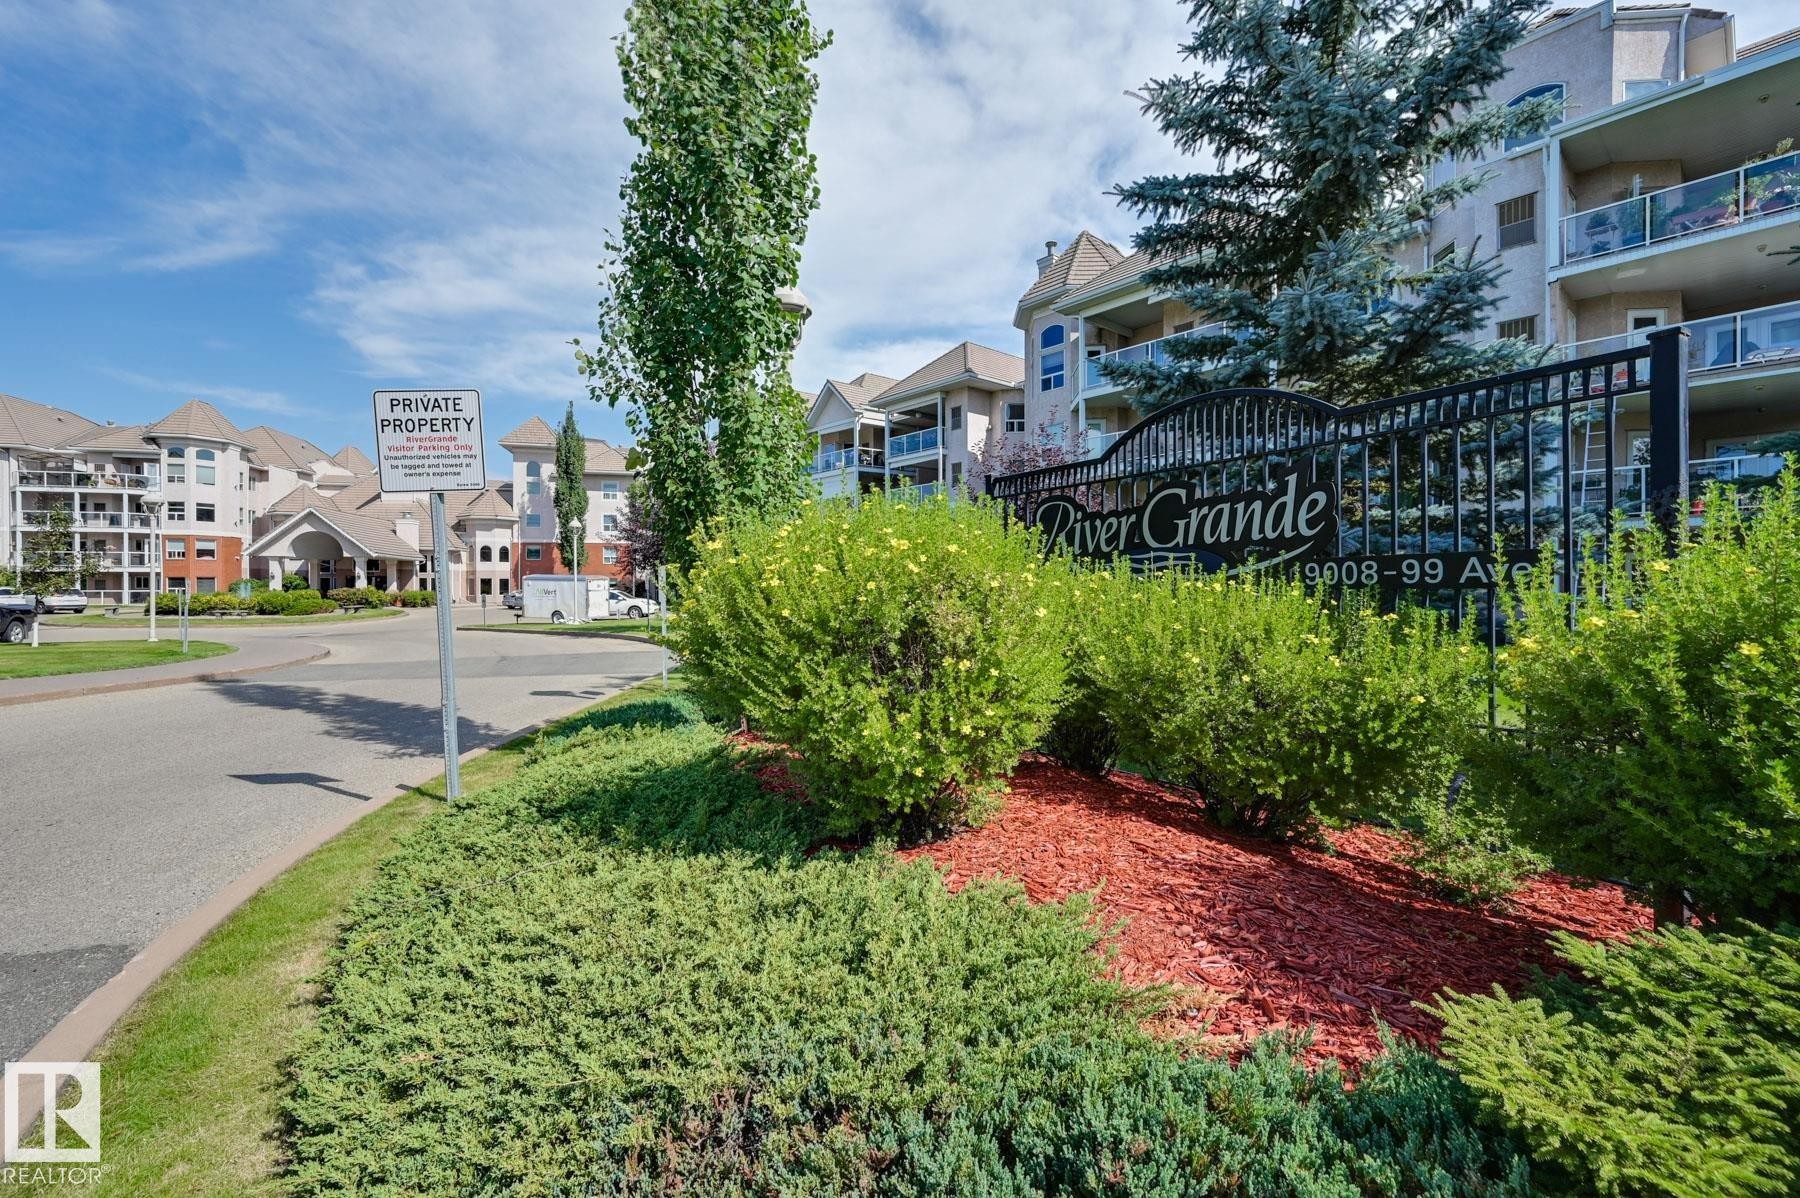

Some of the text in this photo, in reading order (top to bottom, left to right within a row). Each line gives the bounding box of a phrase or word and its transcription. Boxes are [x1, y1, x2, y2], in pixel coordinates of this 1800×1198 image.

[390, 398, 463, 413] PRIVATE
[380, 417, 474, 433] PROPERTY
[406, 435, 458, 443] RiverGrande
[418, 444, 450, 453] Parking
[454, 443, 473, 451] Only
[401, 463, 425, 471] tagged
[1036, 472, 1328, 556] River Grande
